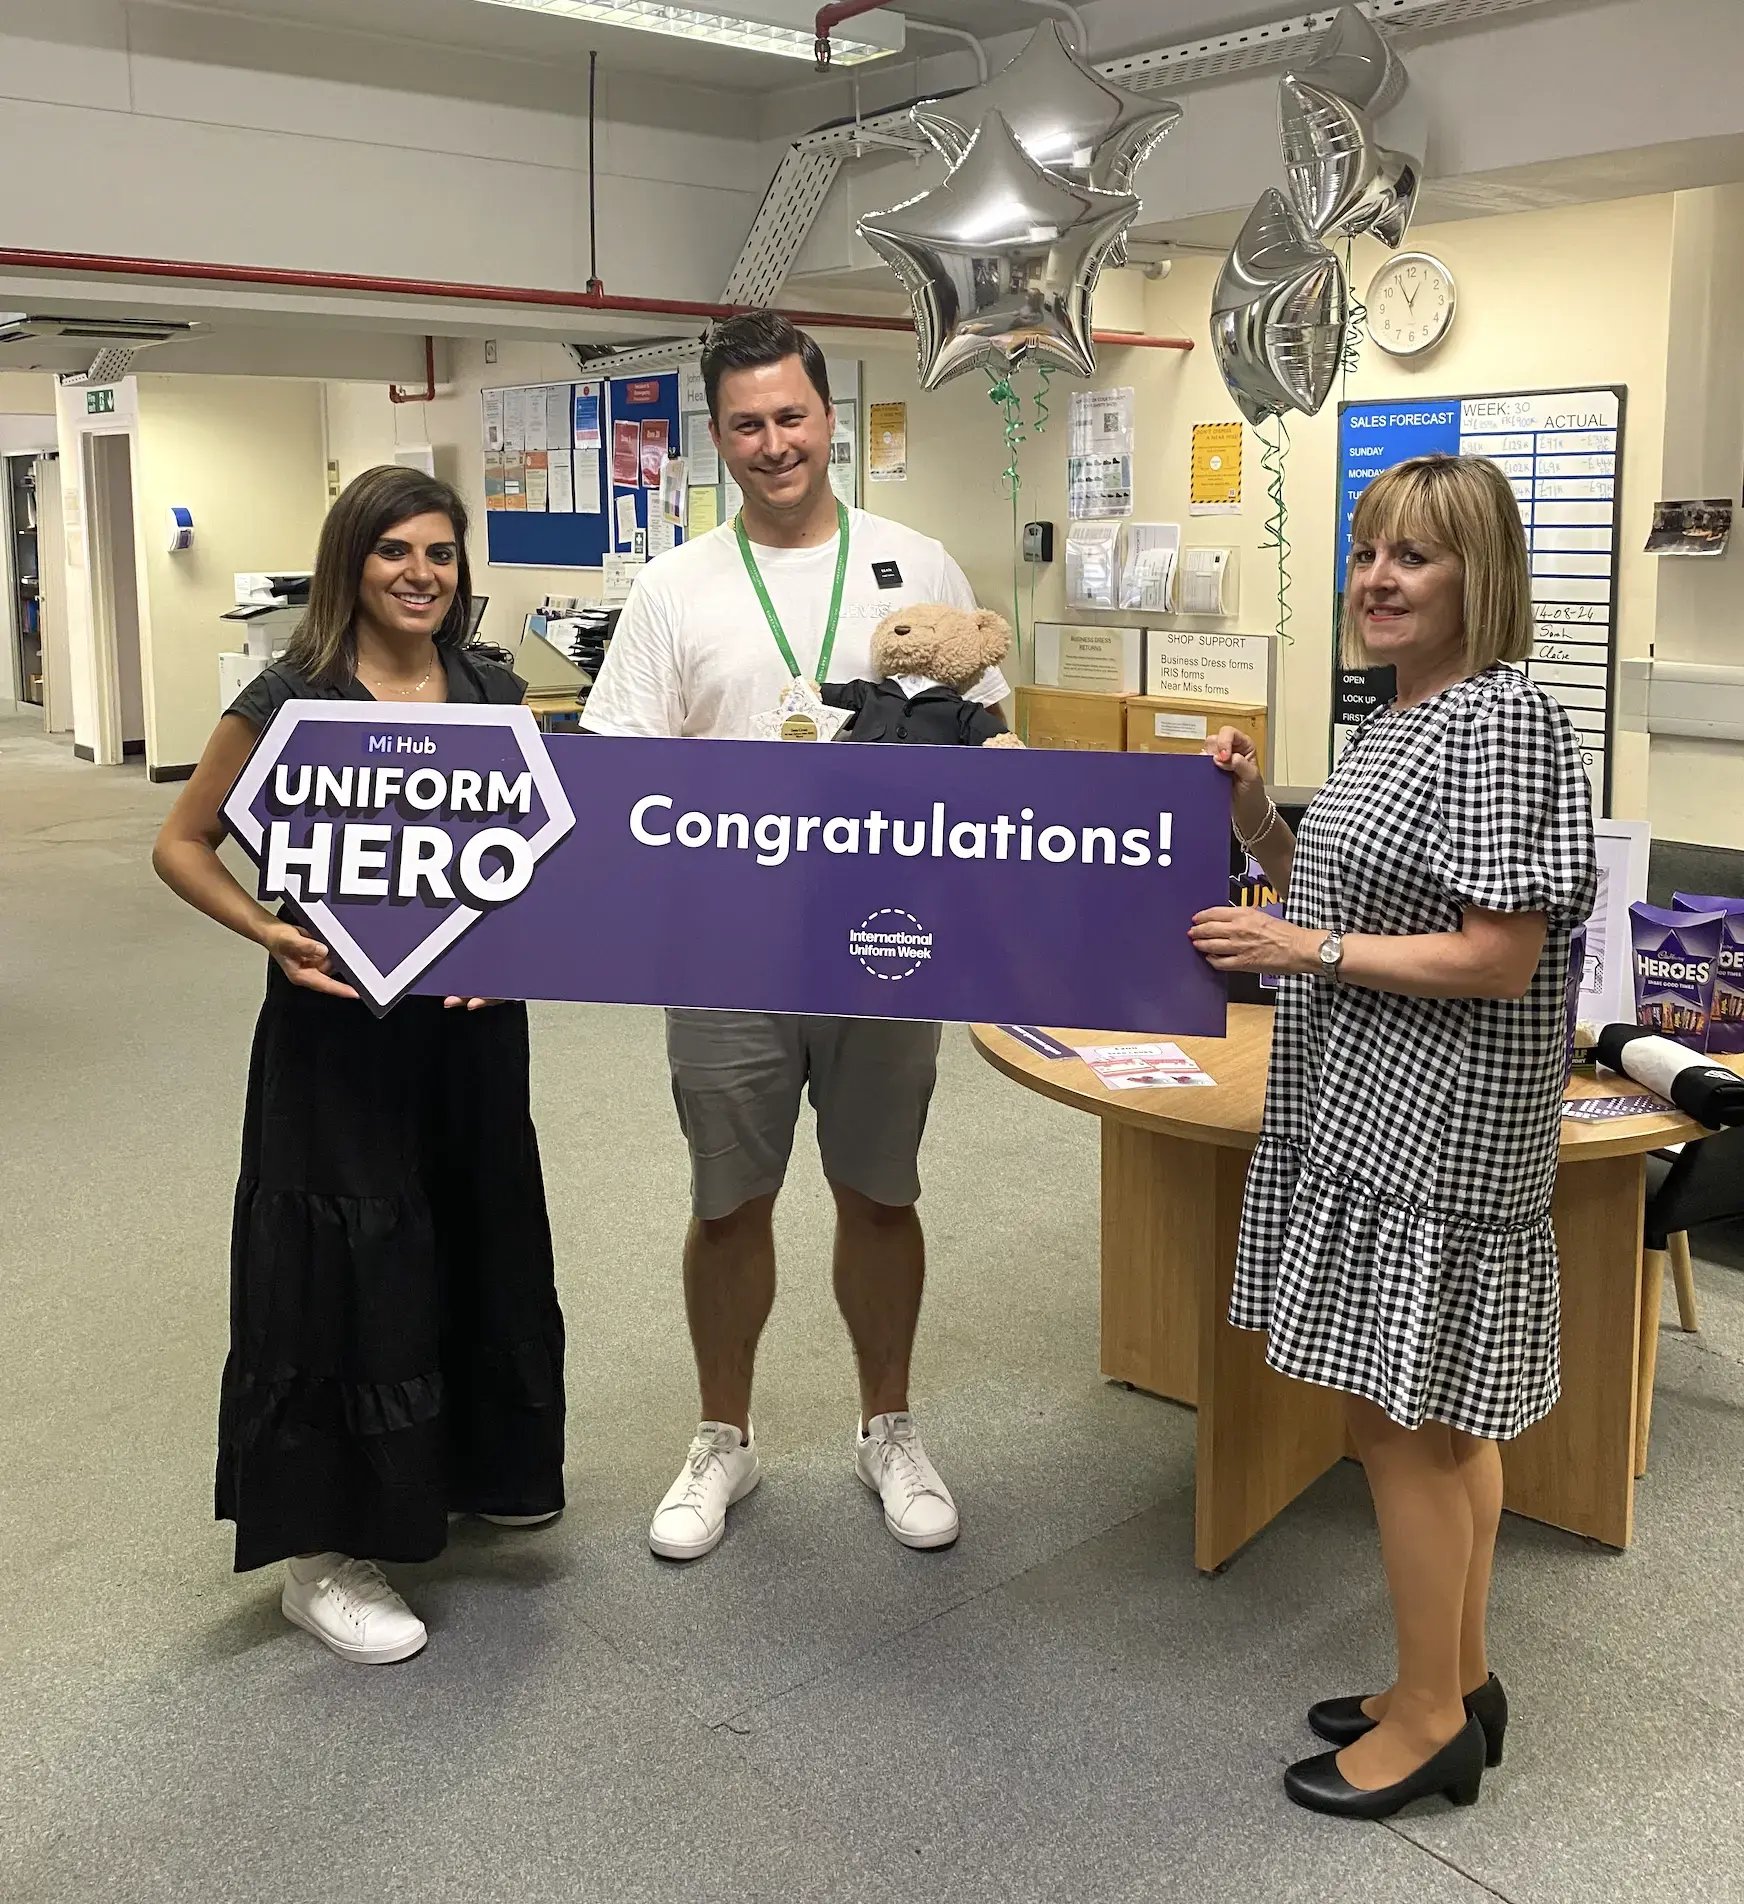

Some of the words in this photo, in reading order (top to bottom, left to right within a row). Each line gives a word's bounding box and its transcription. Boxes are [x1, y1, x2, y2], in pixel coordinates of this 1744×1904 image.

[1406, 266, 1416, 278] 12
[1433, 279, 1440, 290] 2
[1384, 287, 1393, 298] 10
[1438, 295, 1444, 305] 3
[1379, 304, 1385, 314] 9
[1433, 312, 1439, 323] 4
[1384, 319, 1390, 329] 8
[1396, 329, 1401, 340] 7
[1408, 331, 1415, 341] 6
[1422, 325, 1429, 336] 5
[1463, 402, 1510, 416] WEEK:
[1514, 401, 1531, 414] 30
[1350, 415, 1387, 428] SALES
[1389, 412, 1455, 427] FORECAST
[1544, 413, 1608, 429] ACTUAL
[1349, 447, 1384, 456] SUNDAY
[1167, 633, 1194, 645] SHOP
[1198, 635, 1246, 648] SUPPORT
[1161, 654, 1199, 666] Business
[1201, 656, 1227, 668] Dress
[1229, 659, 1254, 670] forms
[1161, 667, 1179, 678] IRIS
[1181, 668, 1205, 680] forms
[1343, 675, 1365, 685] OPEN
[1160, 680, 1181, 691] Near
[1183, 682, 1203, 692] Miss
[1205, 683, 1230, 695] forms
[1342, 694, 1364, 704] LOCK
[1365, 695, 1377, 704] UP
[1342, 712, 1365, 722] FIRST
[368, 735, 393, 753] Mi
[397, 735, 437, 754] Hub
[274, 763, 533, 814] UNIFORM
[628, 794, 1174, 867] Congratulations!
[264, 820, 535, 903] HERO
[849, 929, 933, 946] International
[849, 943, 896, 957] Uniform
[897, 945, 932, 959] Week
[1637, 953, 1710, 984] HEROES
